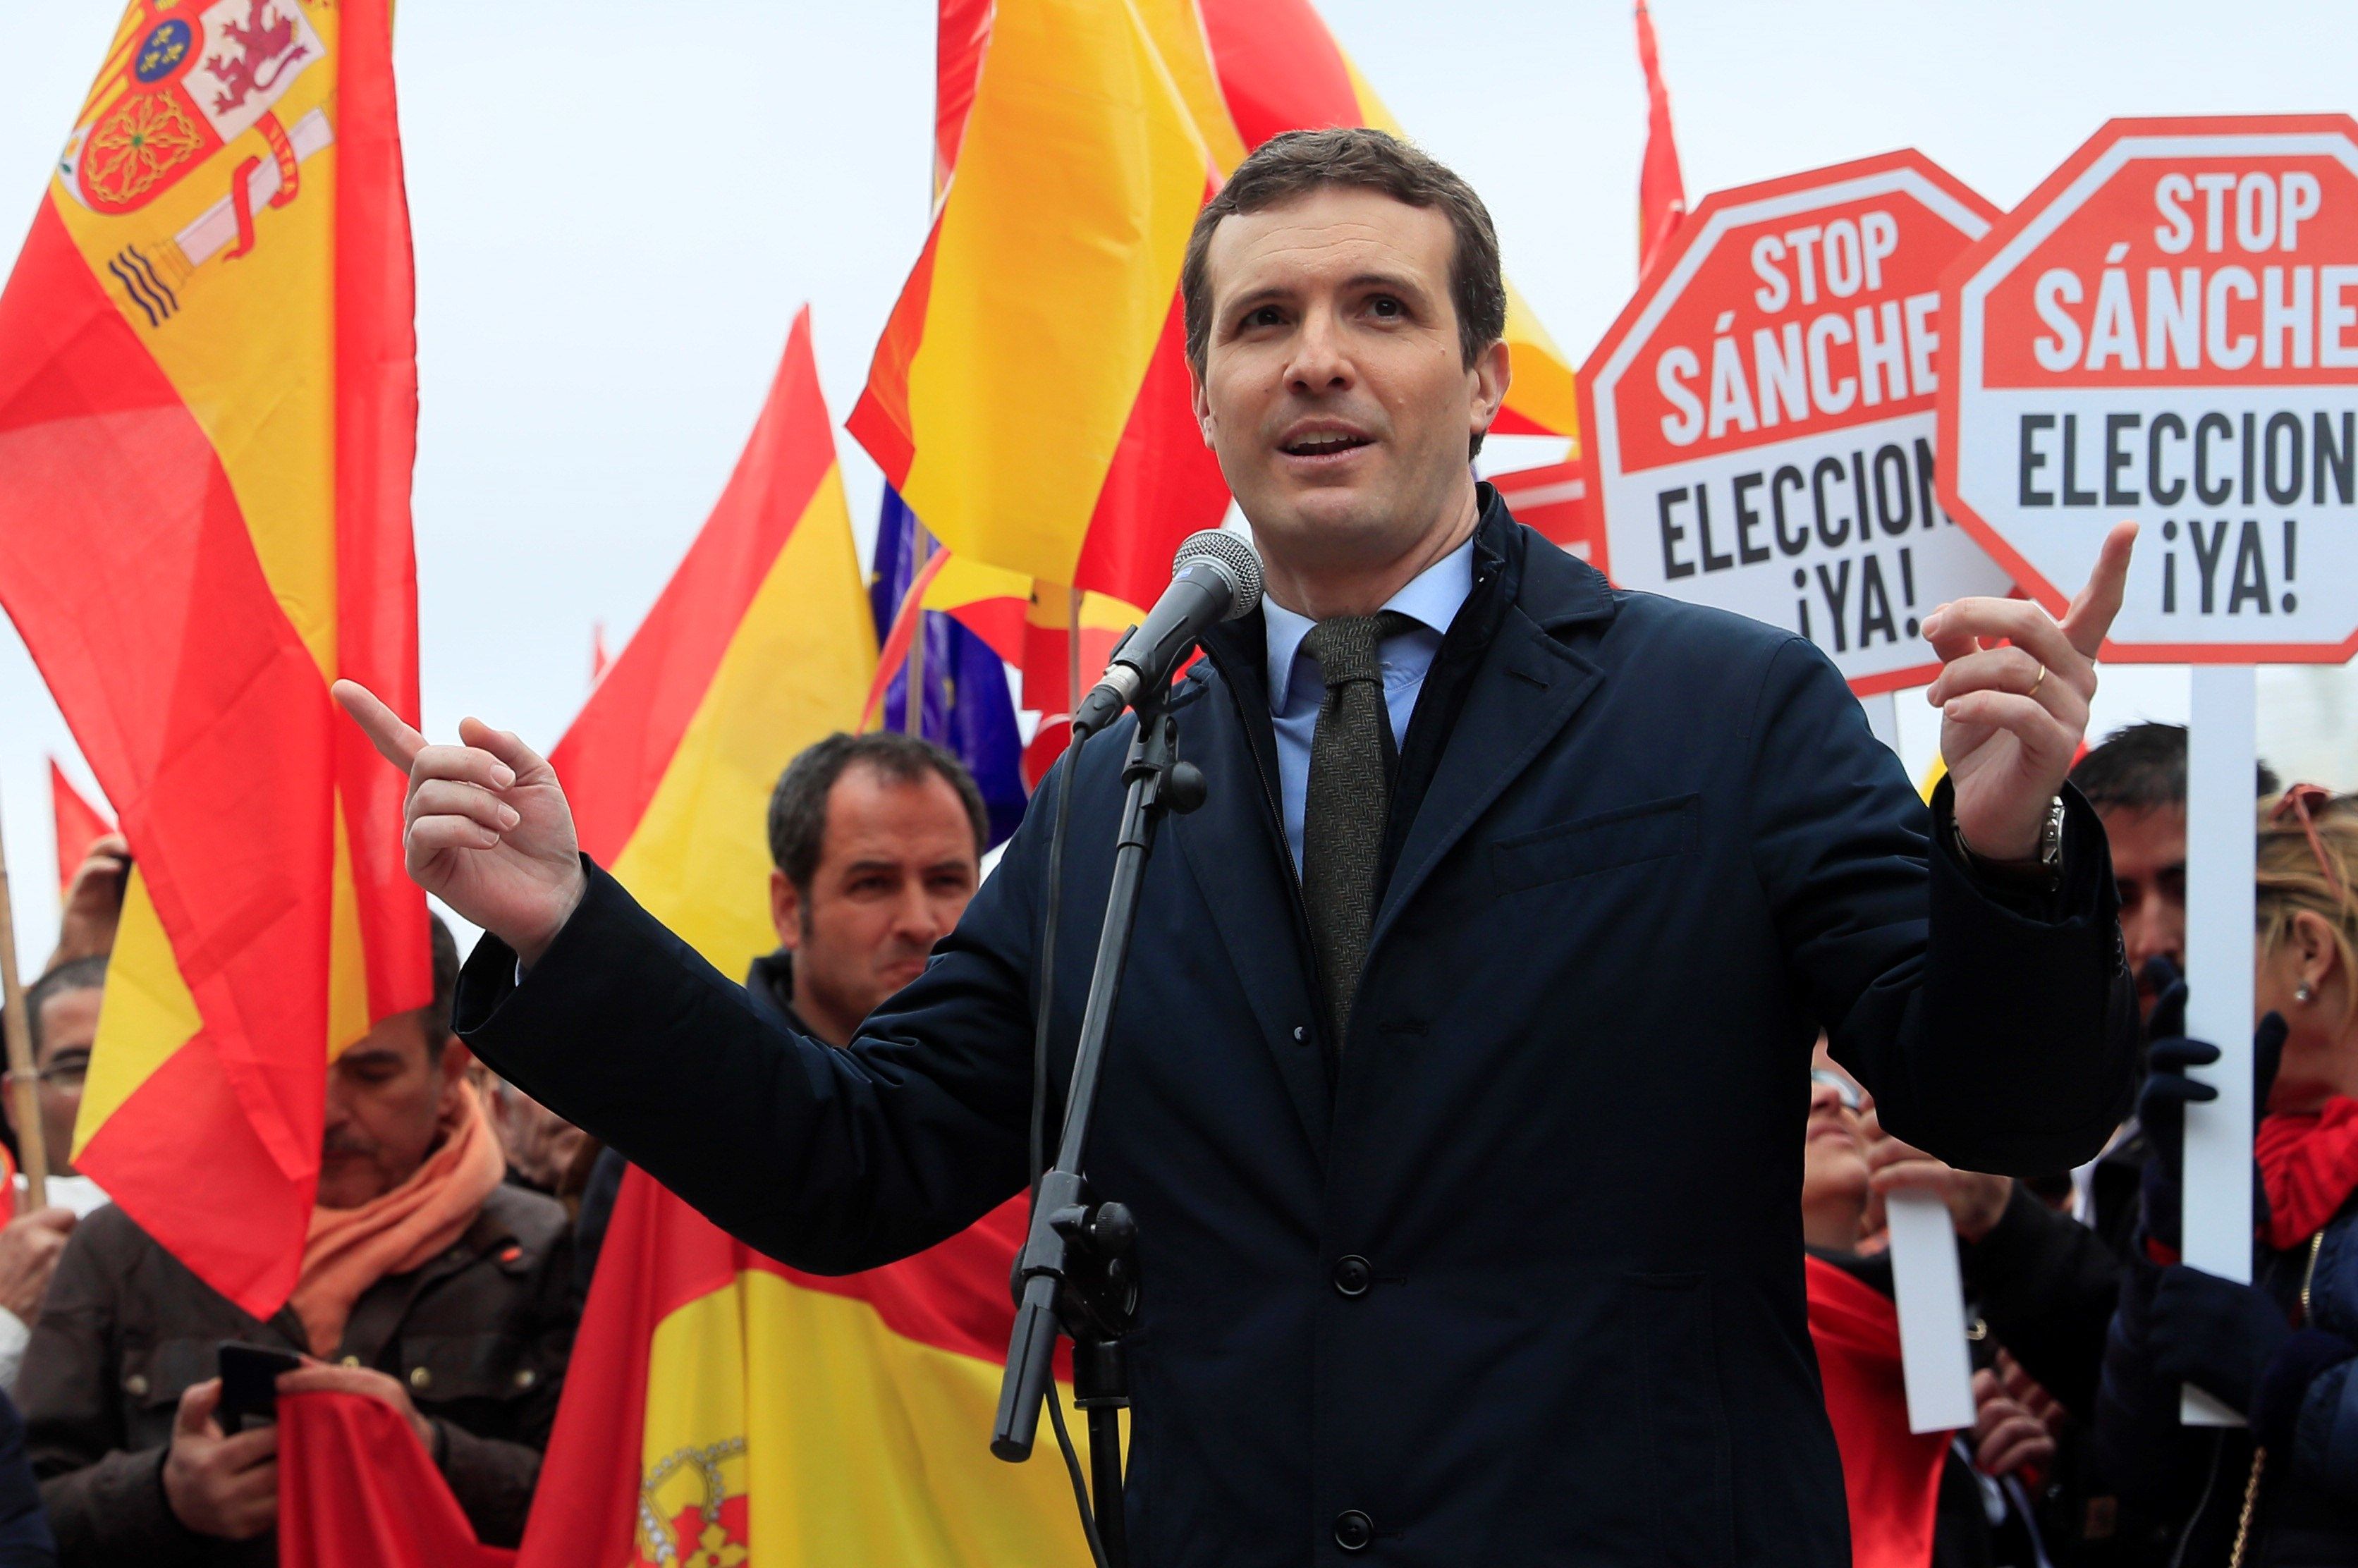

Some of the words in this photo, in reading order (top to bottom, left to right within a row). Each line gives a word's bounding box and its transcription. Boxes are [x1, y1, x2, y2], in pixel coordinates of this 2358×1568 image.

[1751, 211, 1898, 314] STOP
[2154, 172, 2321, 254] STOP
[2033, 242, 2358, 372] SÁNCHE
[1656, 290, 1940, 446] SÁNCHE
[2019, 412, 2355, 506] ELECCION
[1792, 547, 1919, 652] ¡YA!
[2162, 520, 2297, 613] ¡YA!
